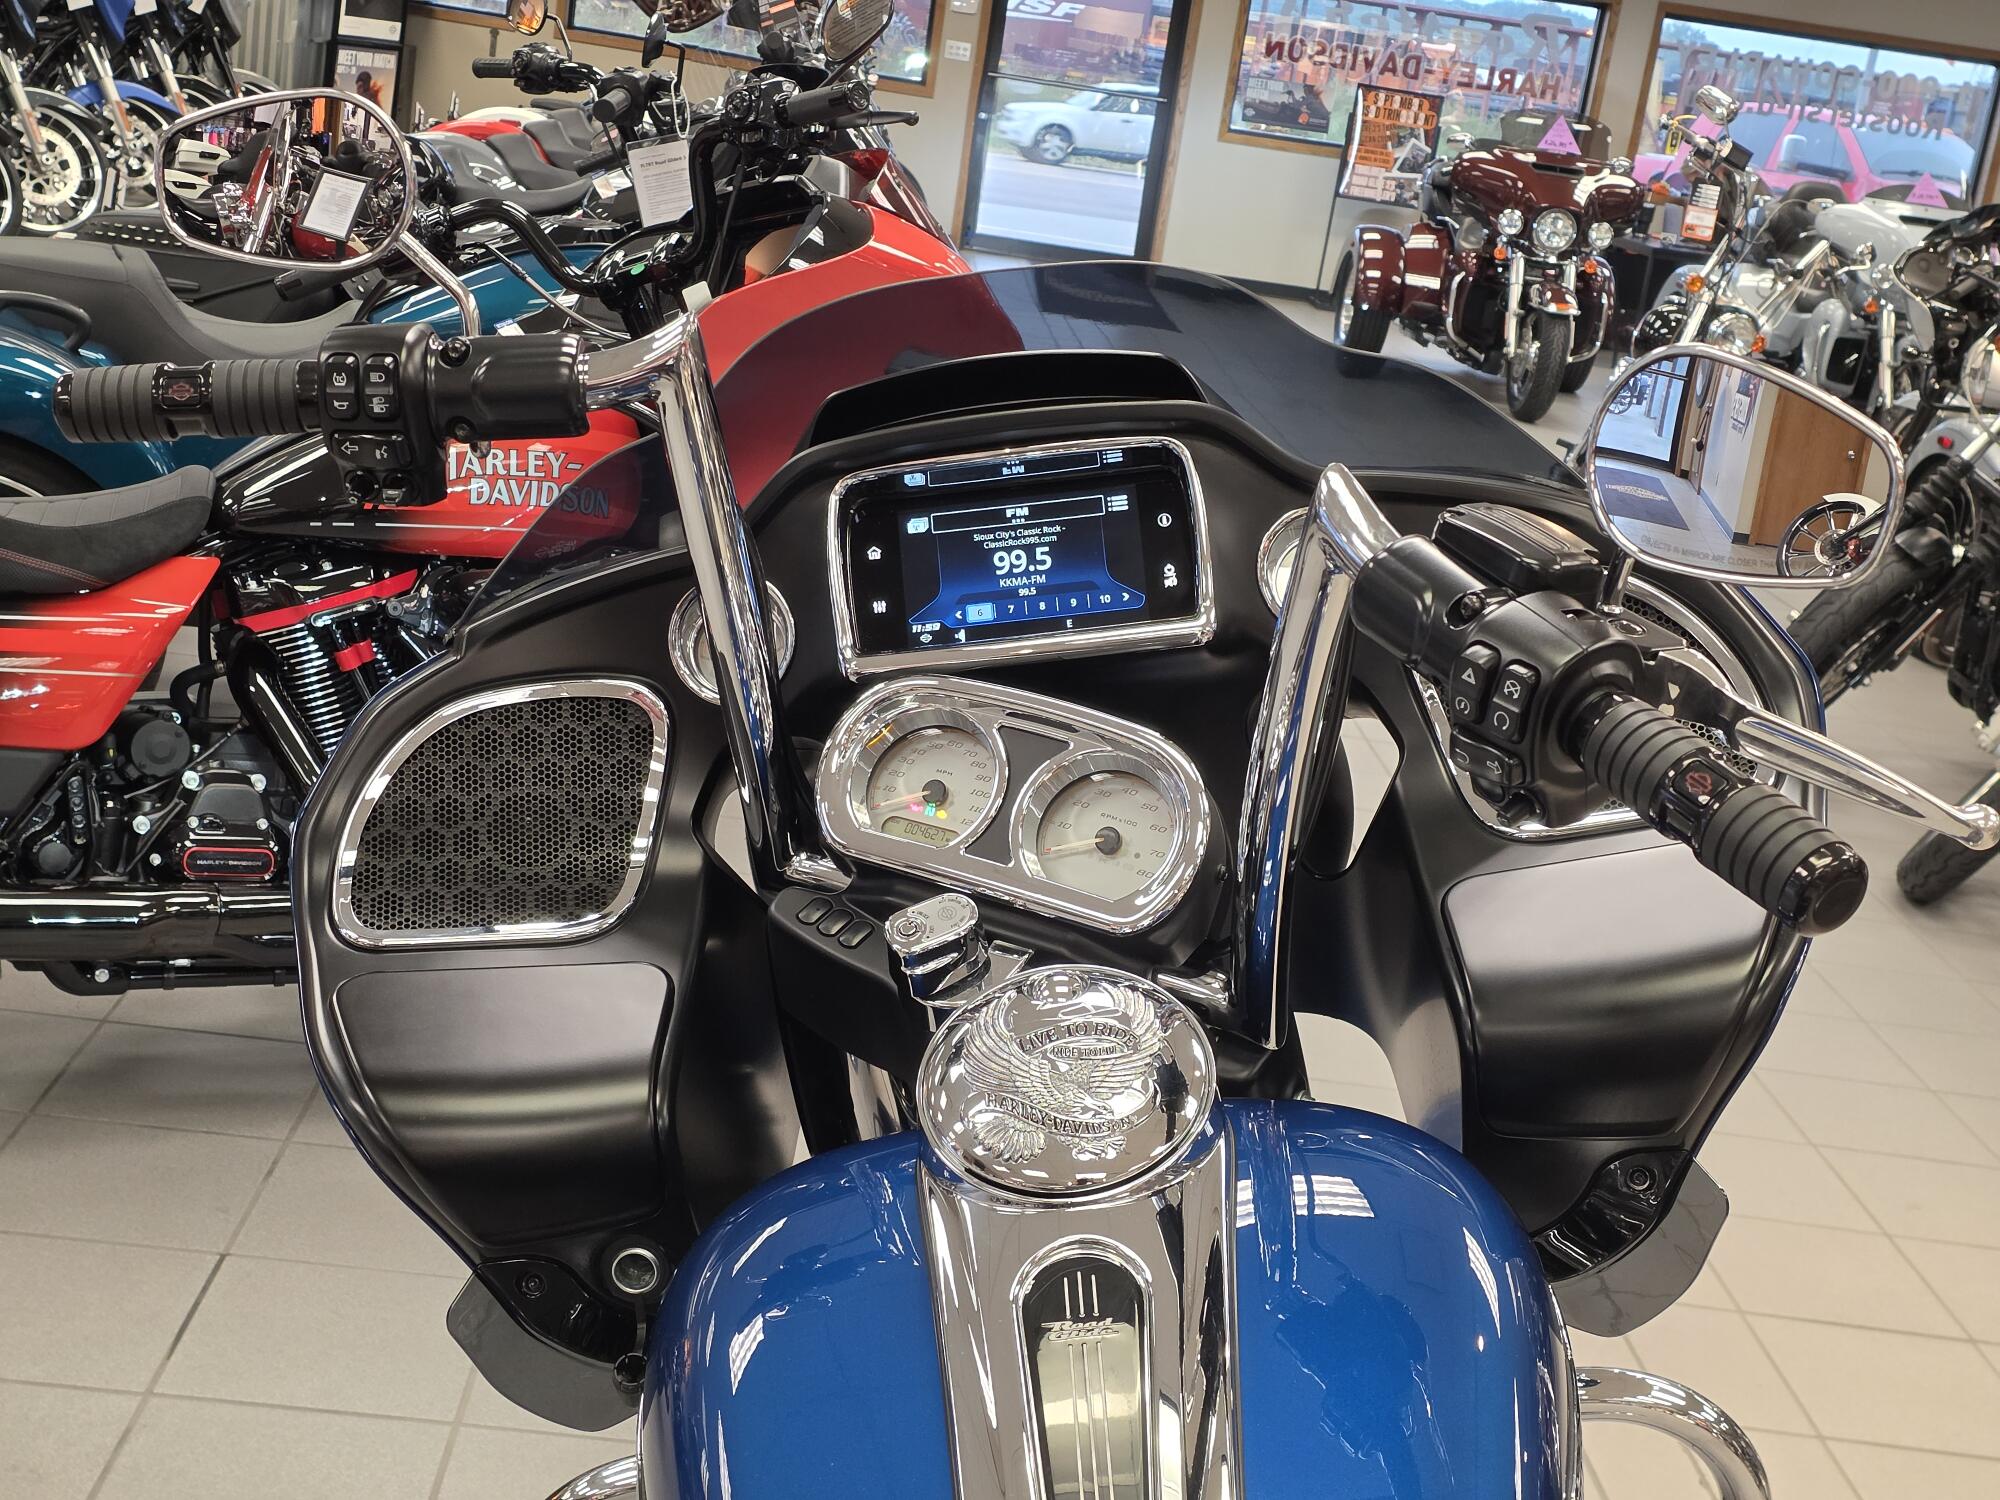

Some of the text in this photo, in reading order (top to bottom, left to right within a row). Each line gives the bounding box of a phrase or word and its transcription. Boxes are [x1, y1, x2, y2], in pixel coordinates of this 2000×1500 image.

[1007, 0, 1086, 17] SF
[469, 476, 609, 518] DAVIDSON
[1005, 507, 1029, 518] FM
[973, 532, 995, 542] Sioux
[995, 529, 1016, 540] City's
[1016, 526, 1042, 537] Classic
[1043, 524, 1062, 534] Rock
[983, 534, 1057, 549] ClassicRock995.com
[993, 546, 1052, 576] 99.5
[999, 574, 1046, 588] KKMA-FM
[1018, 587, 1037, 597] 99.5
[1008, 604, 1014, 613] 7
[1039, 601, 1046, 611] 8
[1070, 598, 1077, 607] 9
[1099, 594, 1111, 604] 10
[911, 621, 941, 633] 11:59
[1067, 620, 1073, 628] E
[927, 741, 944, 750] 50
[961, 749, 978, 758] 70
[970, 760, 987, 769] 80
[888, 769, 905, 778] 20
[974, 774, 992, 783] 90
[882, 785, 896, 793] 10
[970, 789, 991, 799] 100
[1094, 788, 1112, 798] 30
[1121, 787, 1139, 796] 40
[1072, 800, 1090, 809] 20
[1140, 802, 1159, 812] 50
[960, 818, 974, 826] 12
[1057, 821, 1072, 830] 10
[904, 822, 946, 841] 004627
[1149, 824, 1168, 834] 60
[1150, 849, 1165, 858] 70
[1136, 869, 1154, 878] 80
[1017, 1022, 1138, 1052] LIVE TO RIDE
[985, 1092, 1132, 1134] HARLEY-DAVIDSON
[1044, 1317, 1113, 1332] Road
